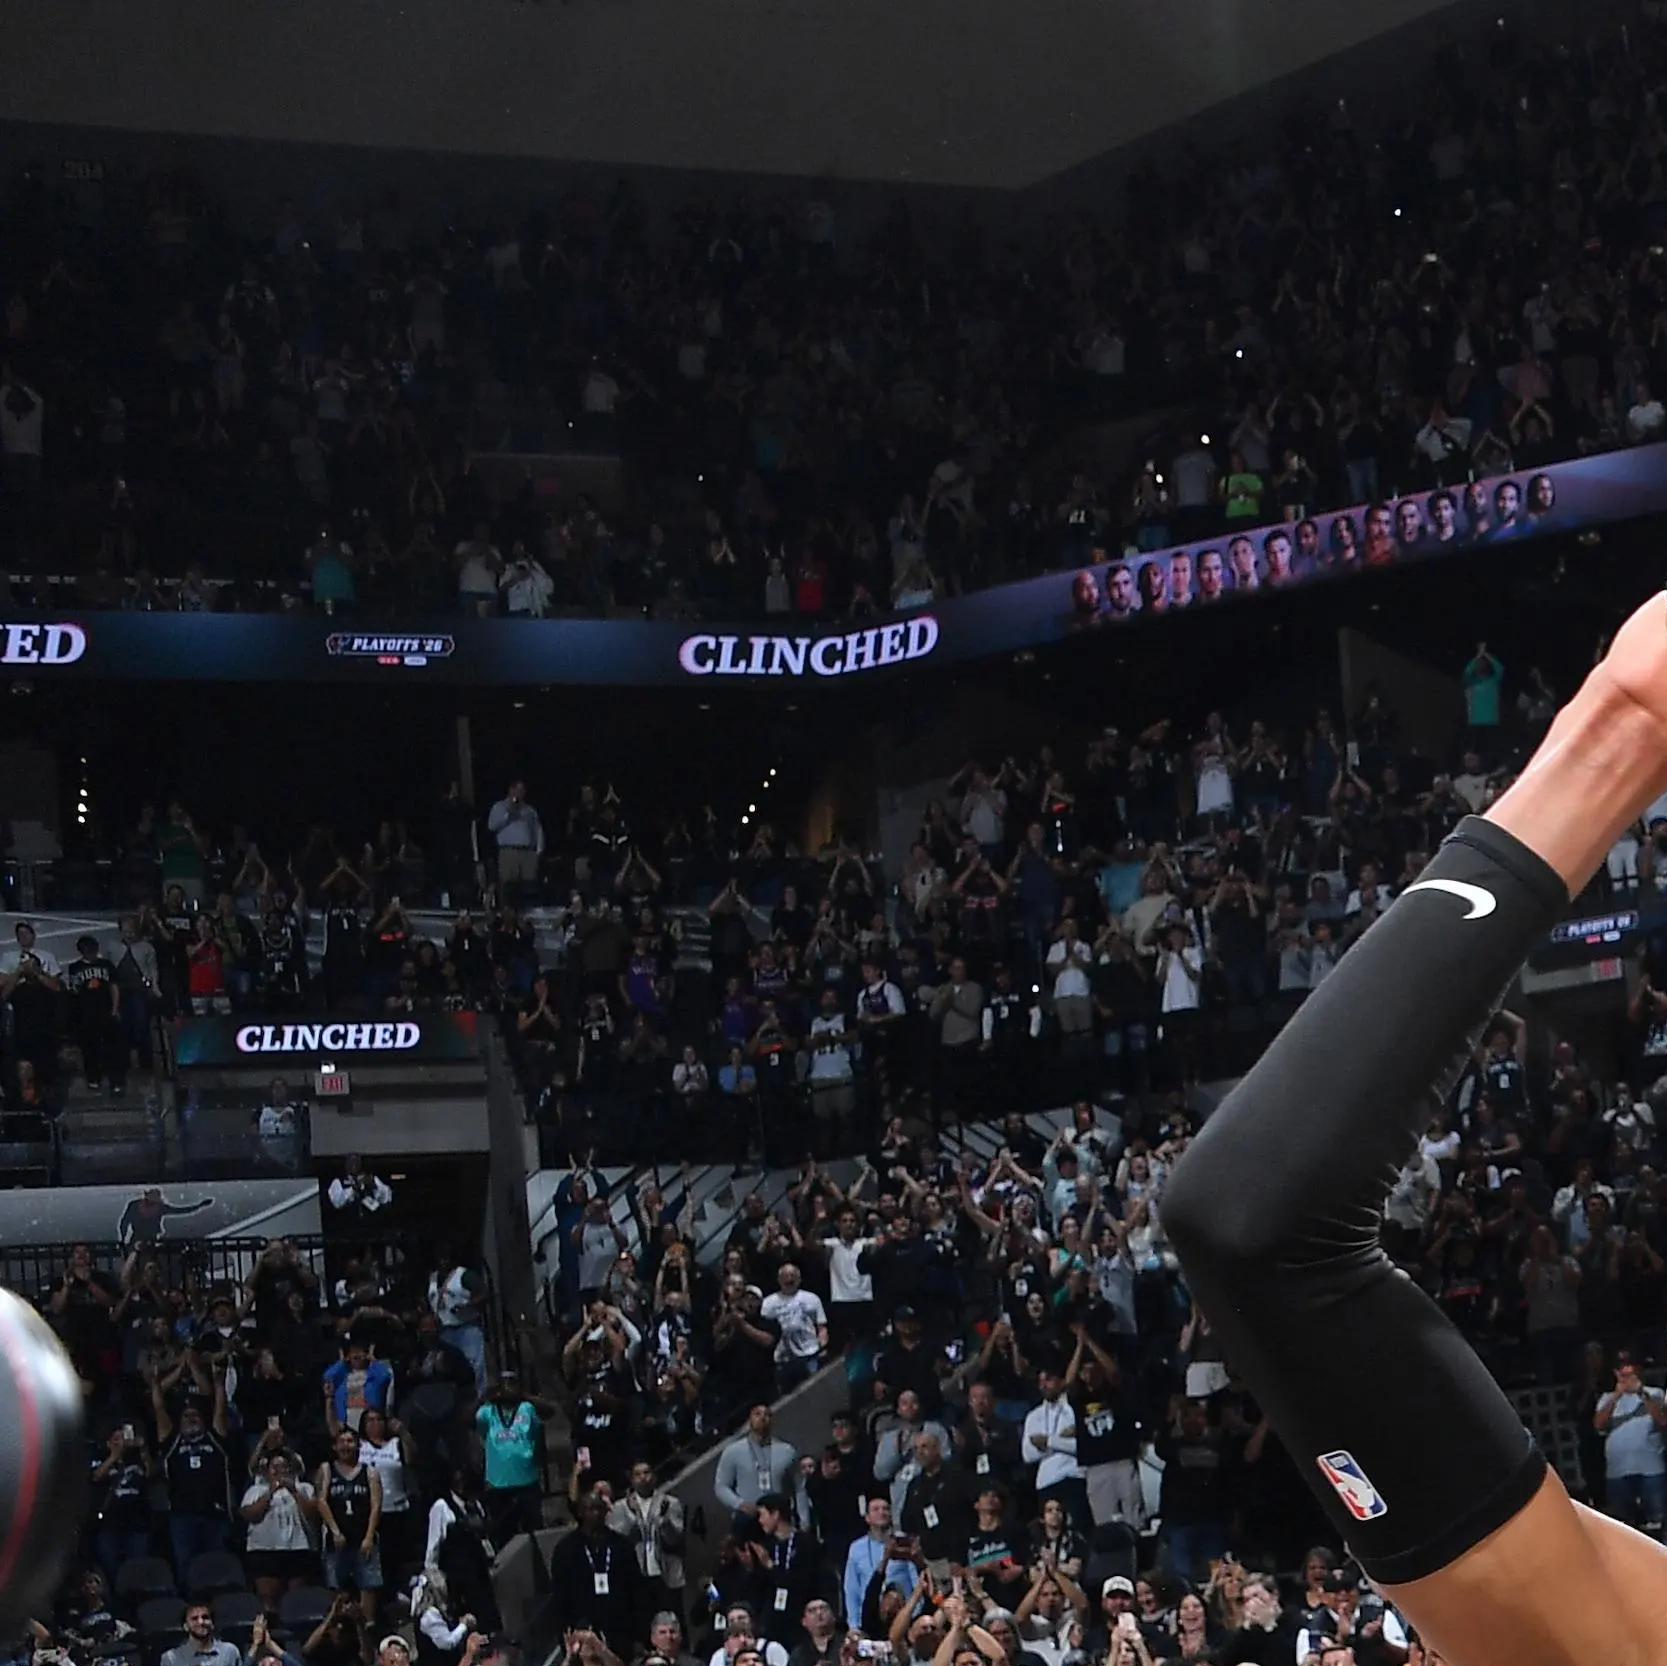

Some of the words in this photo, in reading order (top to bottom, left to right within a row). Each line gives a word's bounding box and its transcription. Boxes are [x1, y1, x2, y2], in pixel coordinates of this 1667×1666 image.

[0, 623, 86, 664] ED
[351, 639, 419, 652] PLAYOFFS
[422, 639, 444, 652] '26
[679, 615, 939, 677] CLINCHED
[236, 1022, 420, 1052] CLINCHED
